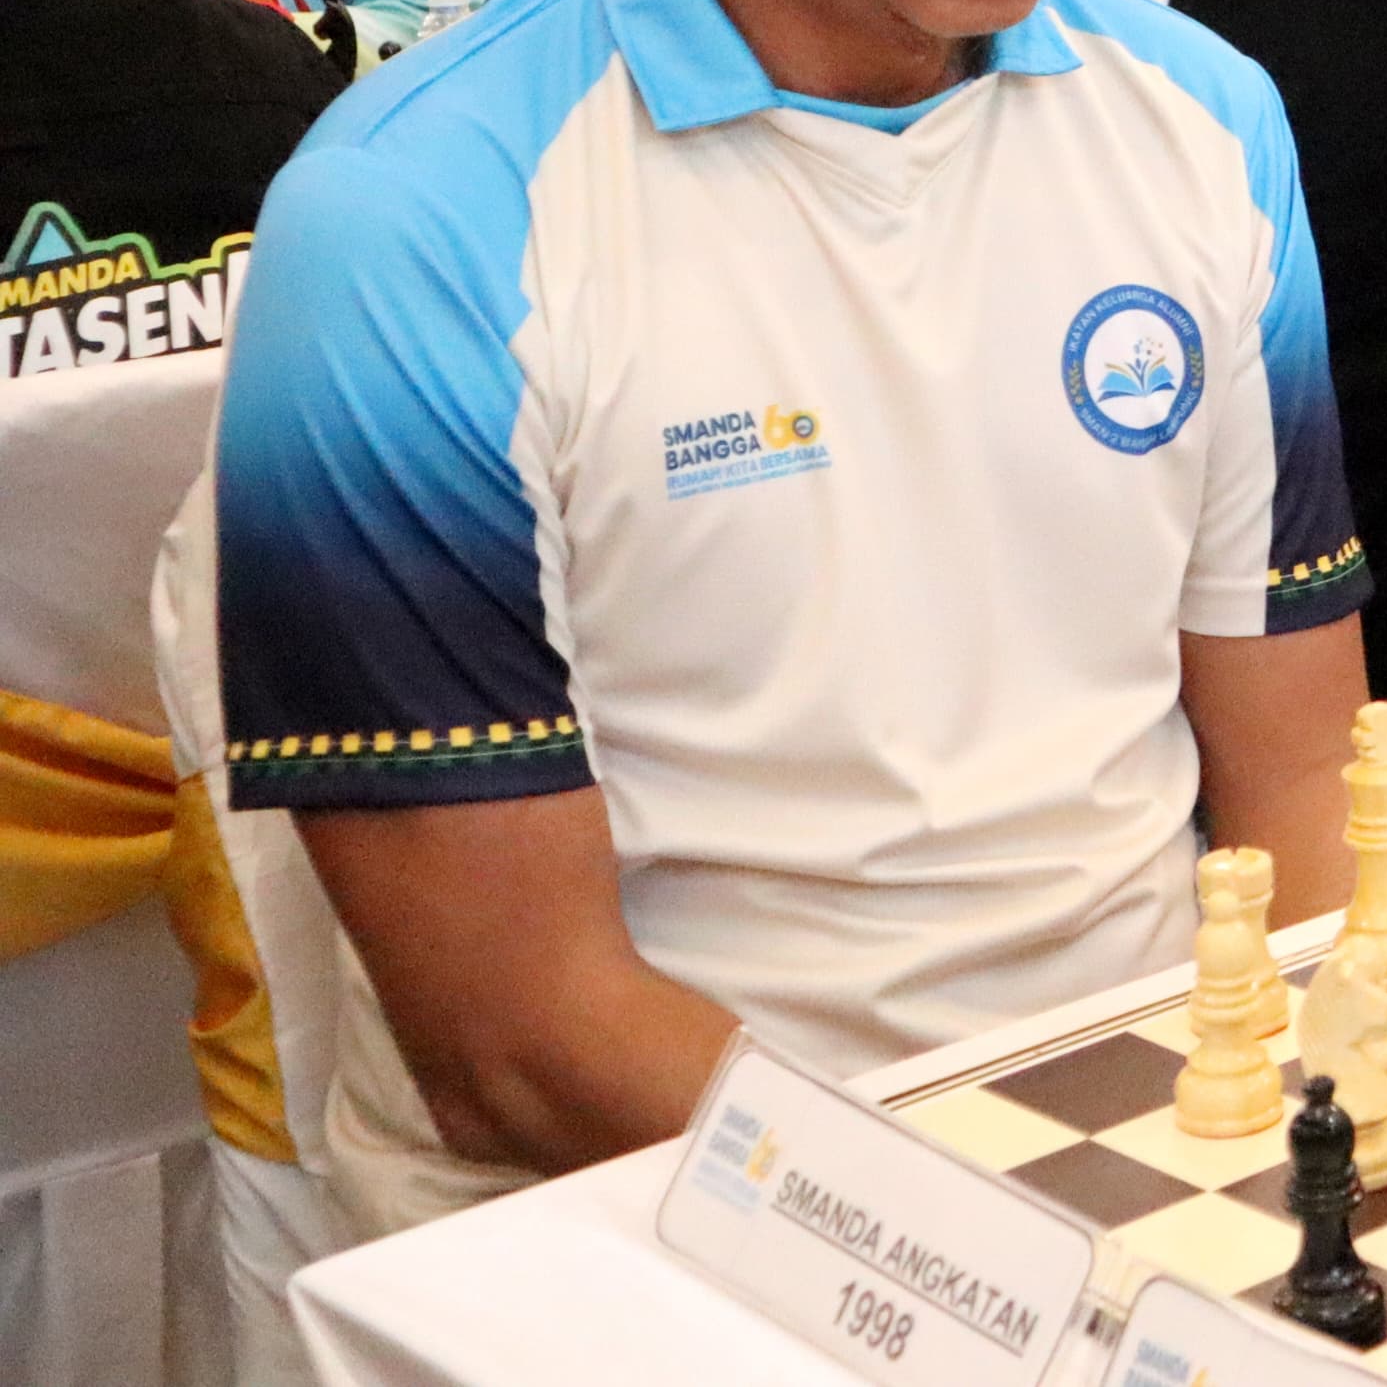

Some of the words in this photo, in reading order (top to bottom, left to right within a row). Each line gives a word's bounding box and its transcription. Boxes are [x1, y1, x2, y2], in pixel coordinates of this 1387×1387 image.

[0, 251, 142, 312] MANDA
[662, 410, 758, 447] SMANDA
[664, 434, 763, 472] BANGGA
[774, 1169, 881, 1258] SMANDA
[885, 1235, 1040, 1347] ANGKATAN
[831, 1280, 916, 1363] 1998
